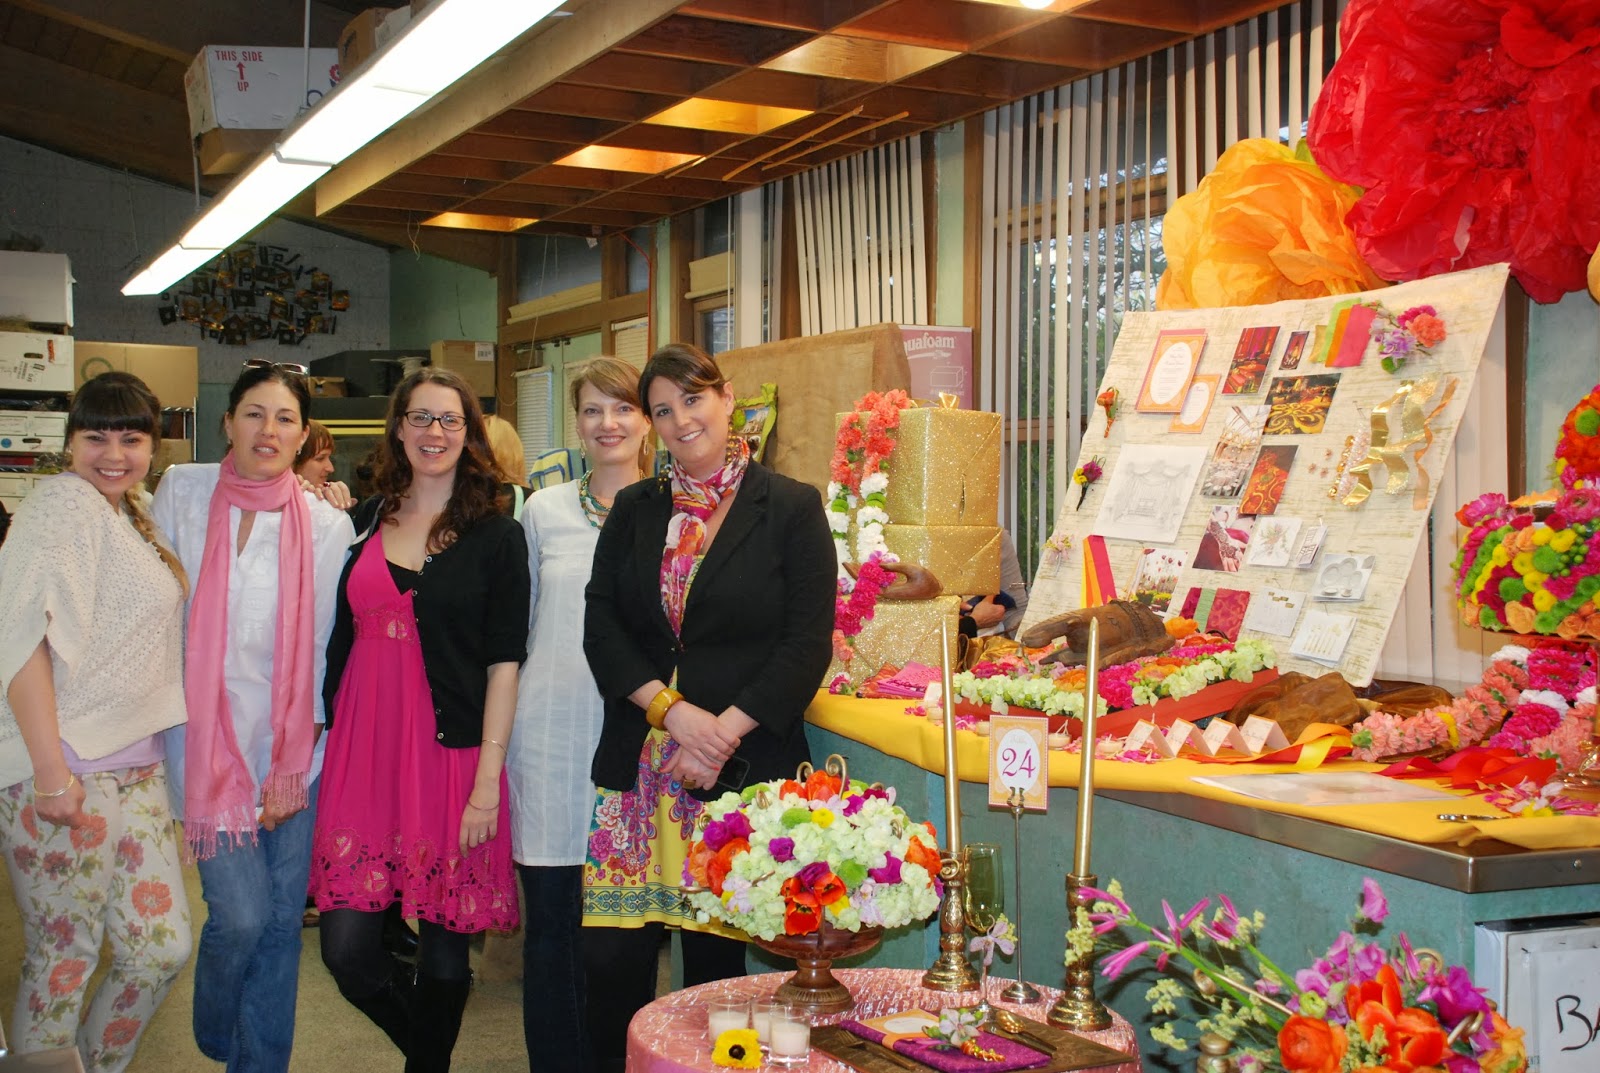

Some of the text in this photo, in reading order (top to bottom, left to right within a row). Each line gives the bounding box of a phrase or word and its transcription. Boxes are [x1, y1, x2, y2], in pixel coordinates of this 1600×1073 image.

[214, 50, 263, 62] THIS SIDE
[237, 81, 249, 92] UP
[1002, 747, 1036, 778] 24
